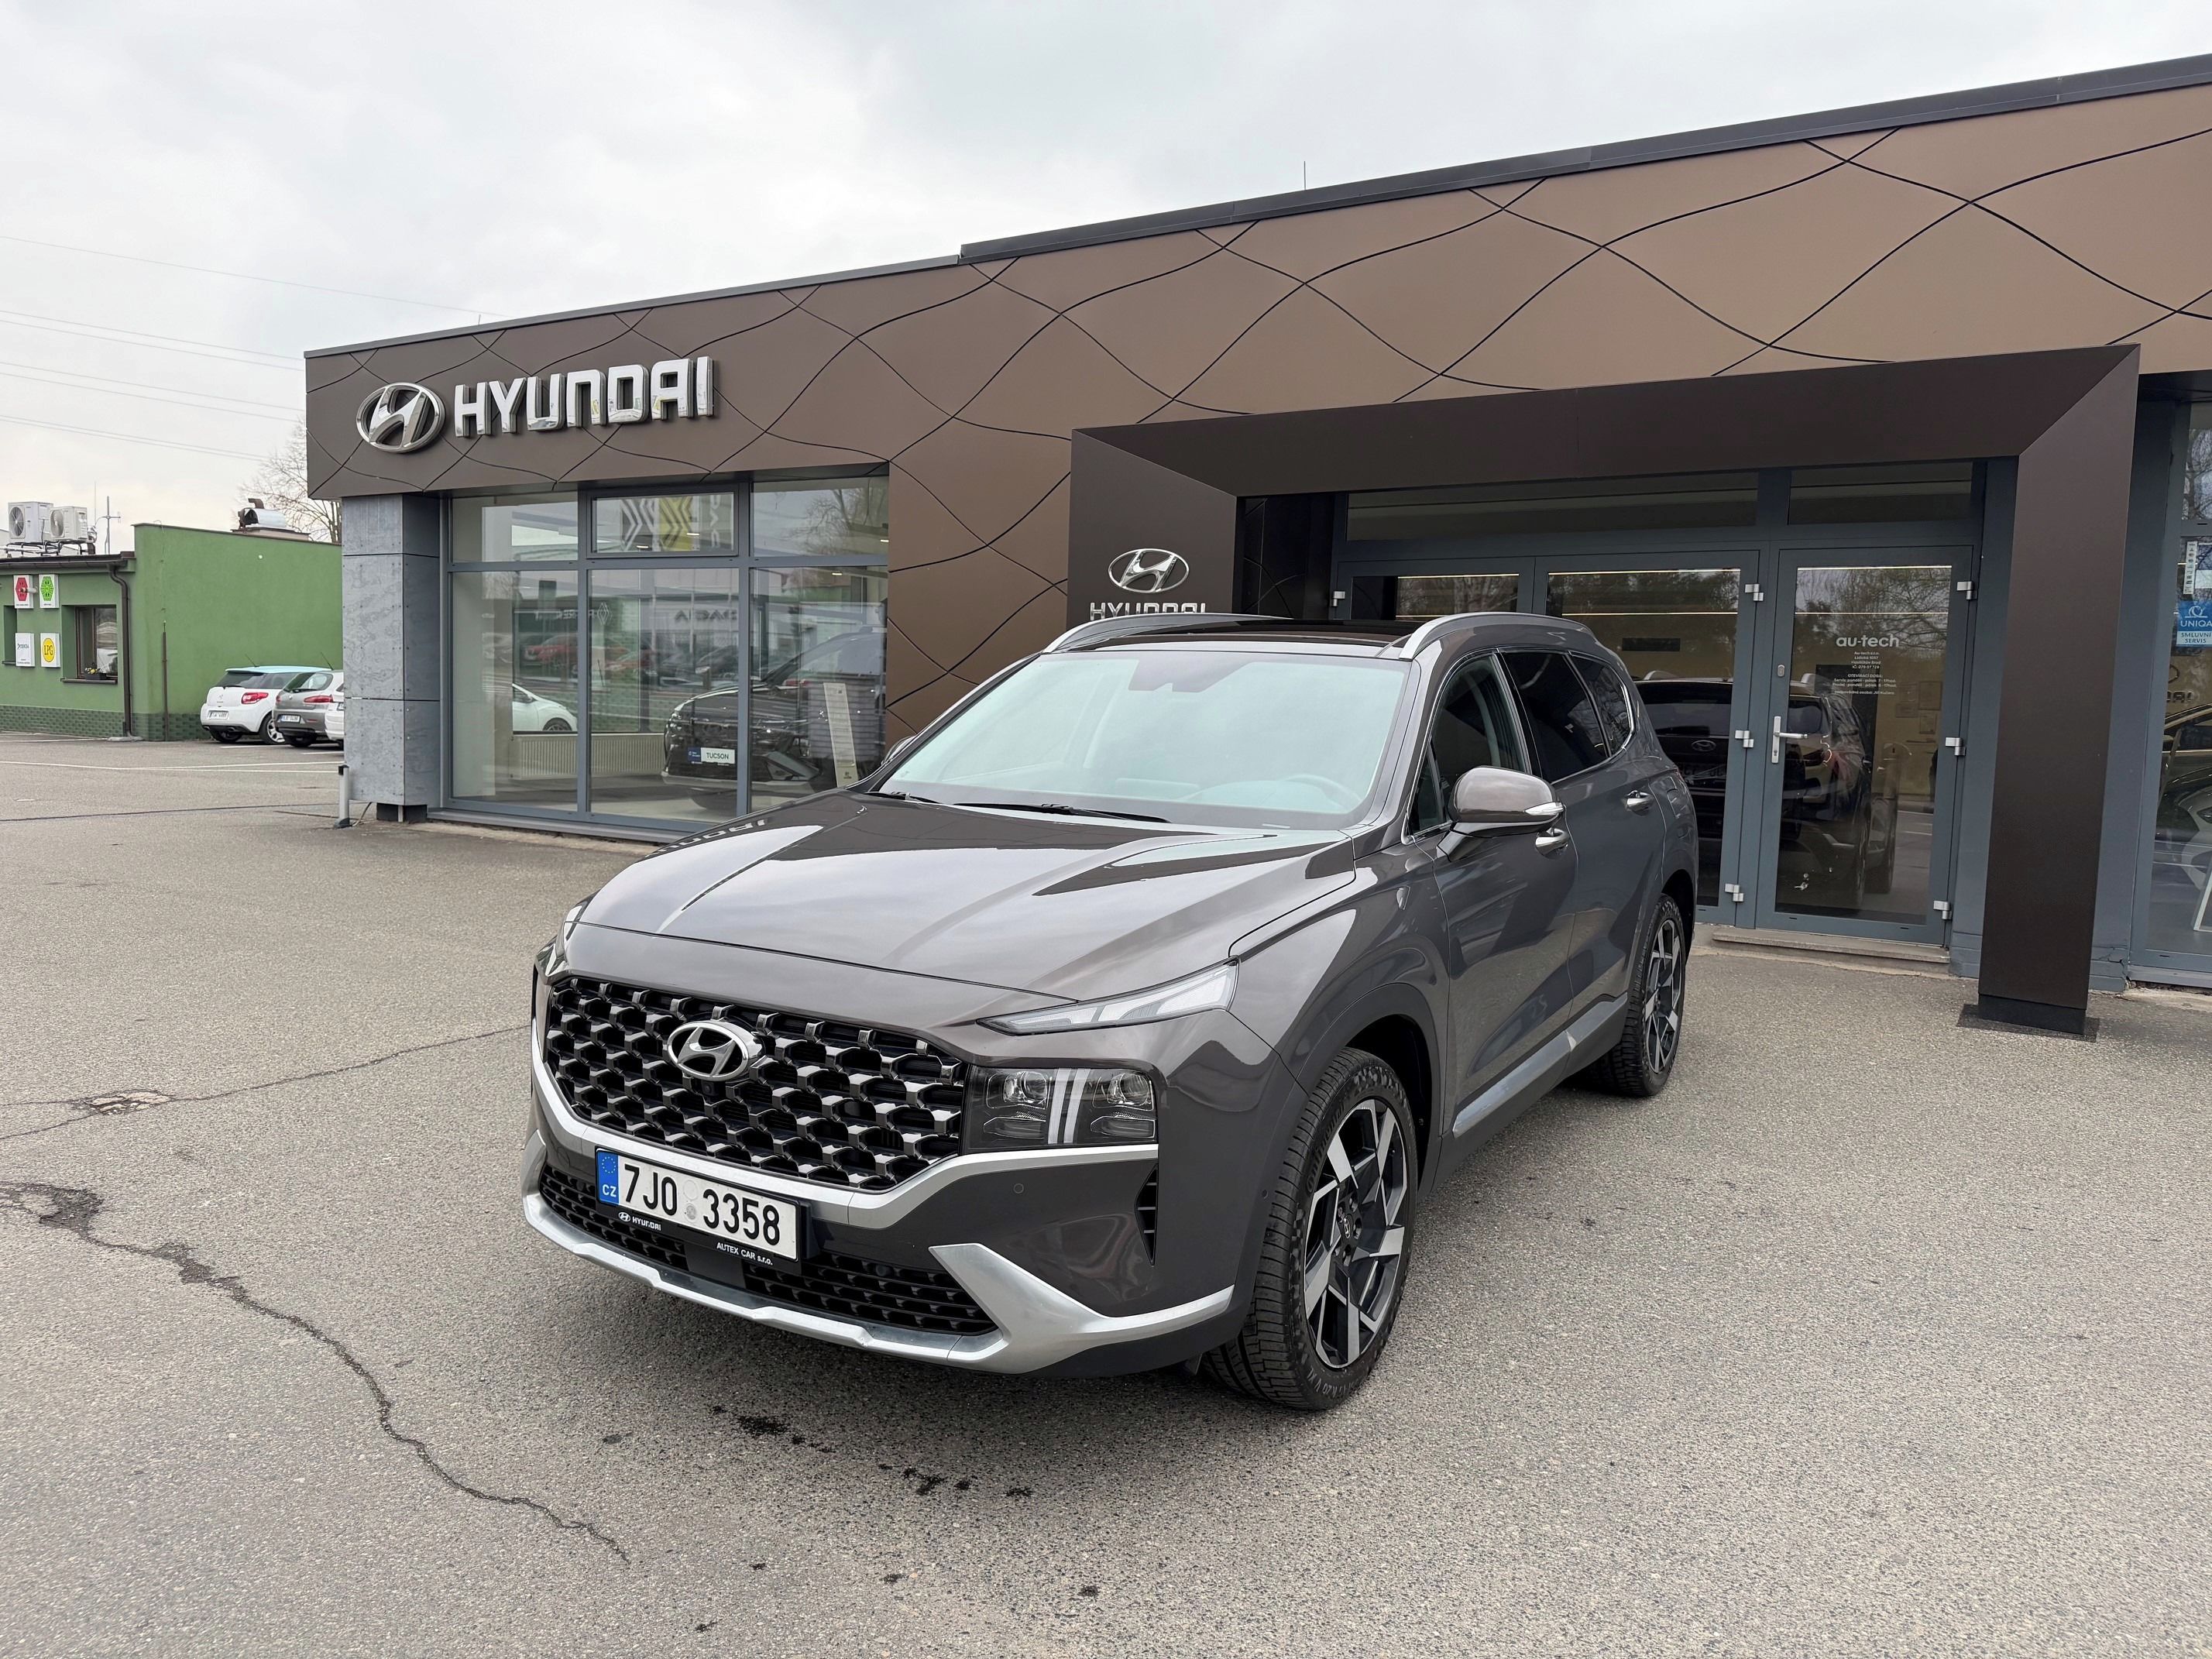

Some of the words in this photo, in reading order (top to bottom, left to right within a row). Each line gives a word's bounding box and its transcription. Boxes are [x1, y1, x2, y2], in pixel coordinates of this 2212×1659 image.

[455, 356, 714, 438] HYUNDAI
[2179, 620, 2212, 628] UNIQA
[1836, 634, 1900, 647] au-tech
[43, 644, 53, 656] LPG
[602, 1183, 617, 1197] CZ
[624, 1163, 678, 1216] 7J0
[702, 1188, 780, 1246] 3358
[632, 1216, 661, 1231] HYUNDAI
[716, 1242, 740, 1255] AUTEX
[740, 1249, 756, 1260] CAR
[757, 1255, 773, 1266] s.r.o.
